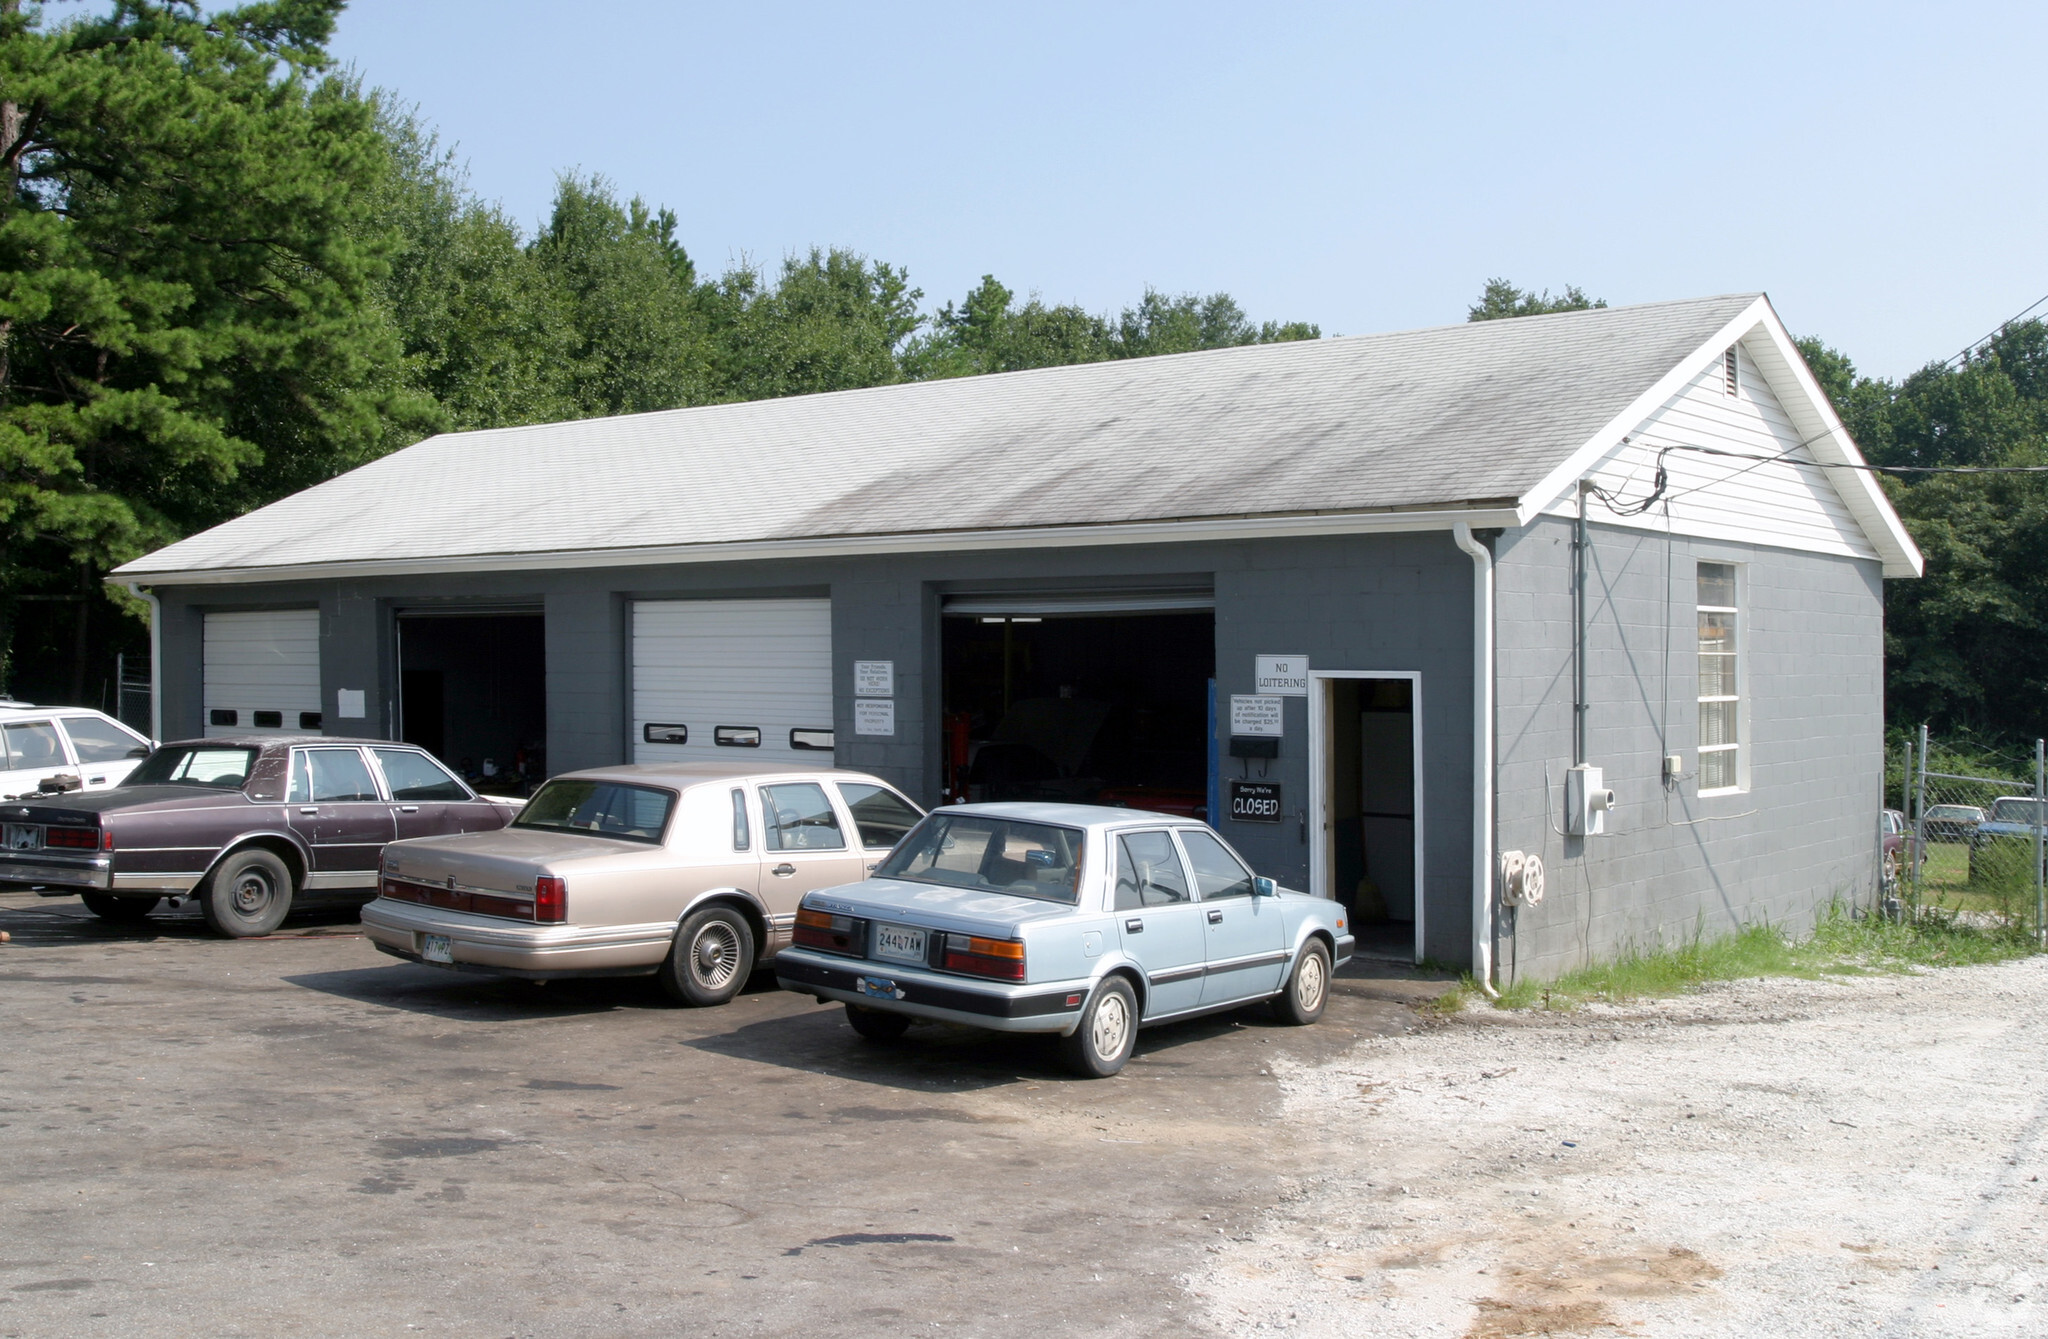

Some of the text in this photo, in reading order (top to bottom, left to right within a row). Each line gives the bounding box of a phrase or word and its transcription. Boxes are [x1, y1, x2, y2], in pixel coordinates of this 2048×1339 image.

[1275, 663, 1288, 673] NO
[1259, 677, 1306, 688] LOITERING
[1240, 785, 1272, 795] Sorry We're
[1233, 798, 1279, 815] CLOSED
[879, 932, 897, 949] 244
